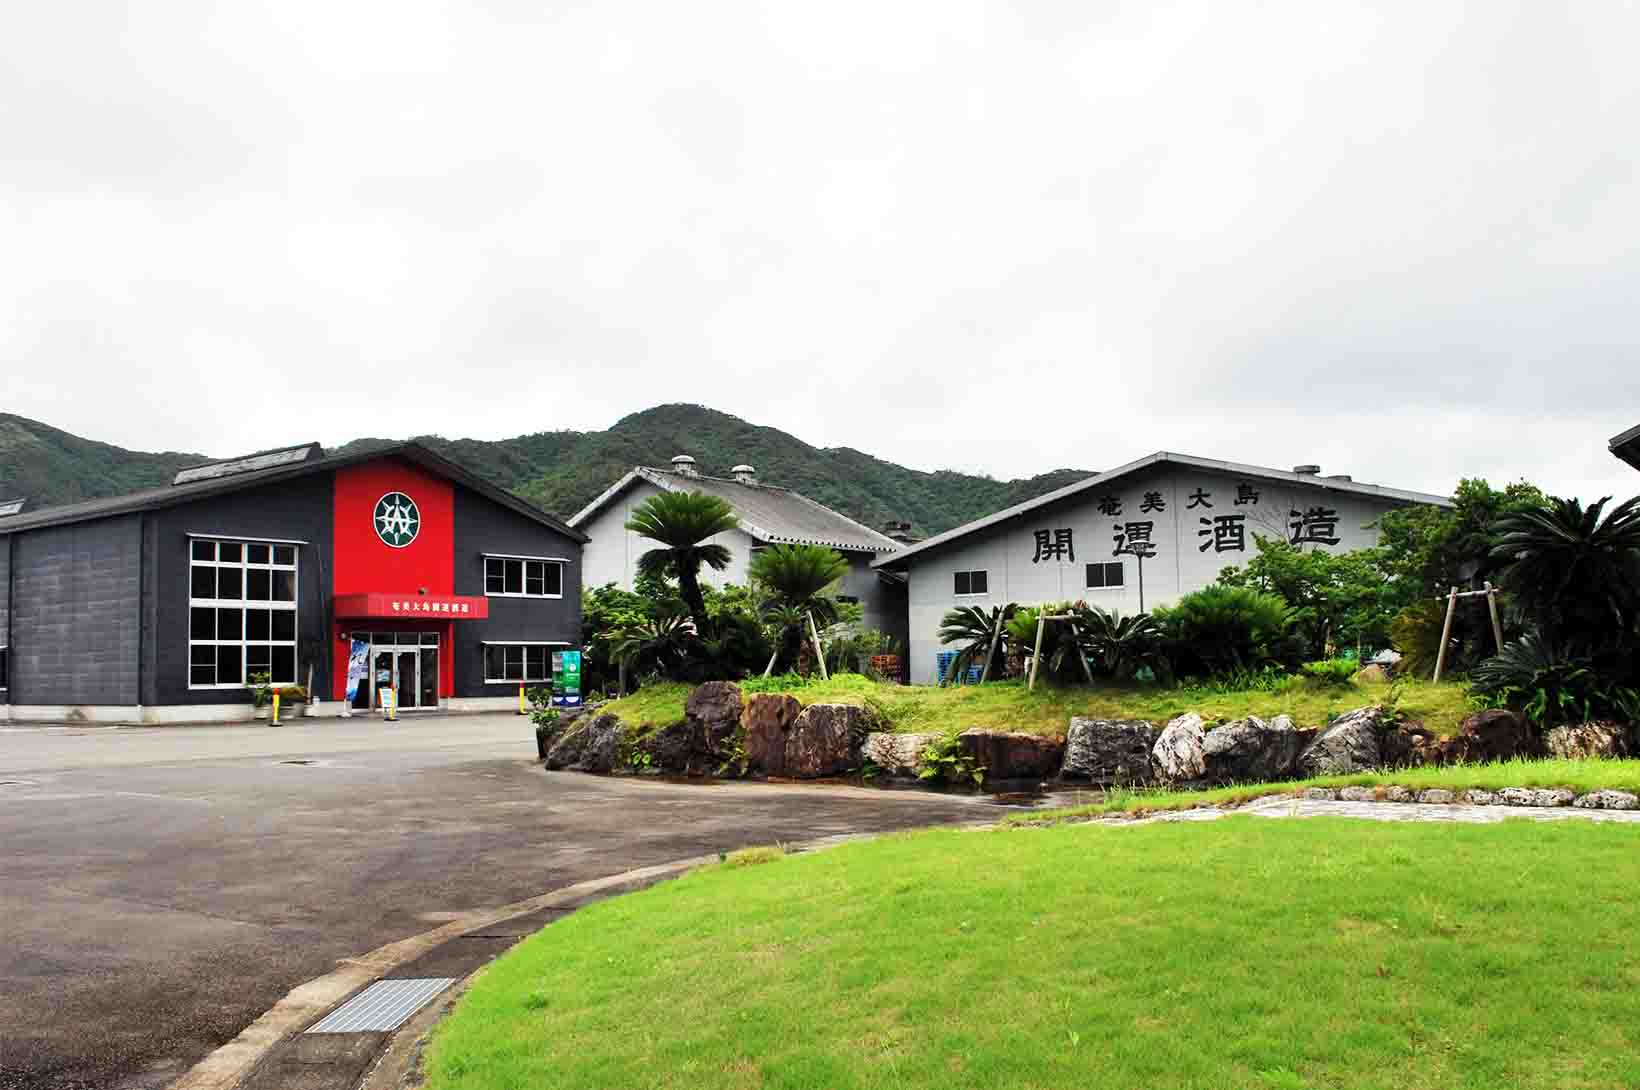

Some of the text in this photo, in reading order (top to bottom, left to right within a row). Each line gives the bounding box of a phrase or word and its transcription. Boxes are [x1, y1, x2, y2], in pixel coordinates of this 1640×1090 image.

[1097, 483, 1260, 516] 奄美大島
[1032, 507, 1341, 563] 開運酒造
